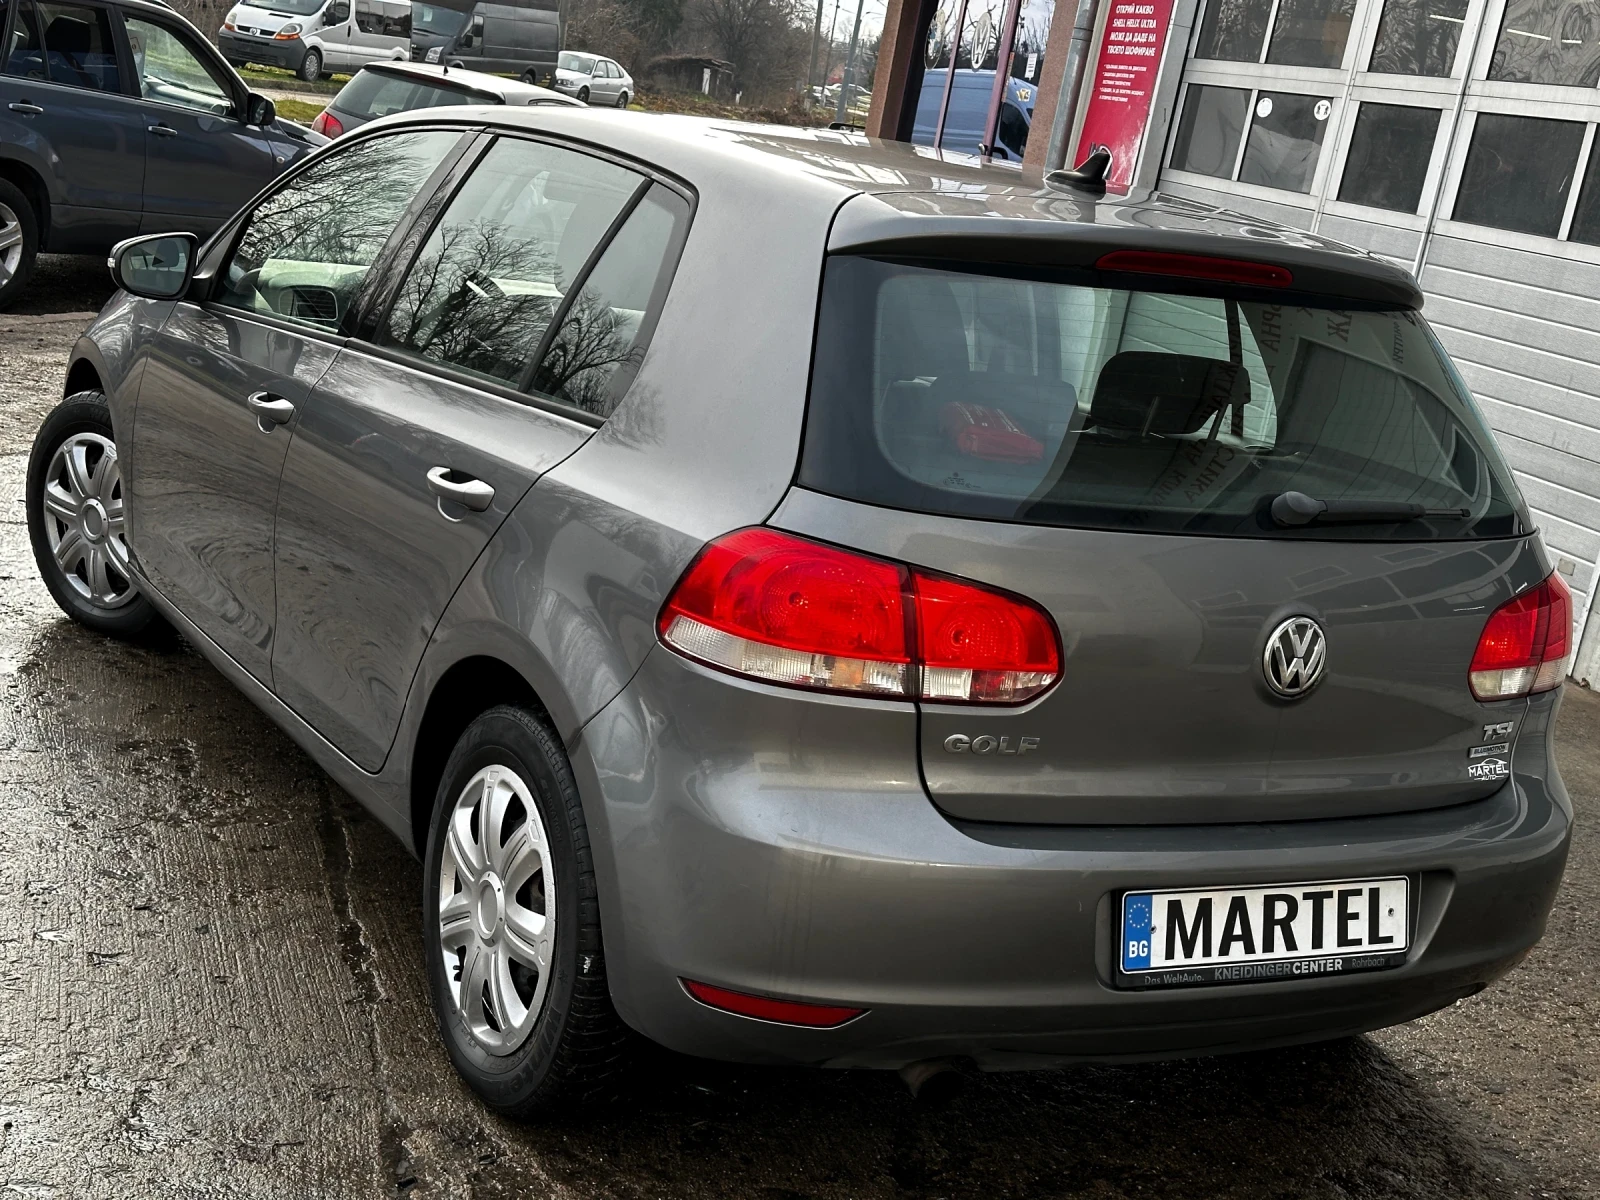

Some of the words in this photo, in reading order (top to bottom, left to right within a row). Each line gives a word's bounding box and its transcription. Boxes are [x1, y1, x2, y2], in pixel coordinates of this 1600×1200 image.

[1115, 3, 1135, 14] ОТКРИЙ
[1135, 5, 1155, 15] КАКВО
[1112, 18, 1126, 28] SHELL
[1126, 18, 1141, 28] HELIX
[1140, 19, 1157, 29] ULTRA
[1109, 31, 1126, 41] МОЖЕ
[1124, 32, 1133, 42] ДА
[1132, 33, 1148, 44] ДАДЕ
[1148, 33, 1156, 42] НА
[1107, 45, 1125, 55] ТВОЕТО
[1124, 46, 1156, 57] ШОФИРАНЕ
[1483, 721, 1514, 741] TSI
[943, 733, 1041, 756] GOLF
[1467, 763, 1509, 777] MARTEL
[1164, 887, 1394, 961] MARTEL
[1128, 940, 1148, 958] BG
[1144, 975, 1161, 985] Das
[1351, 957, 1385, 969] Rohrbach
